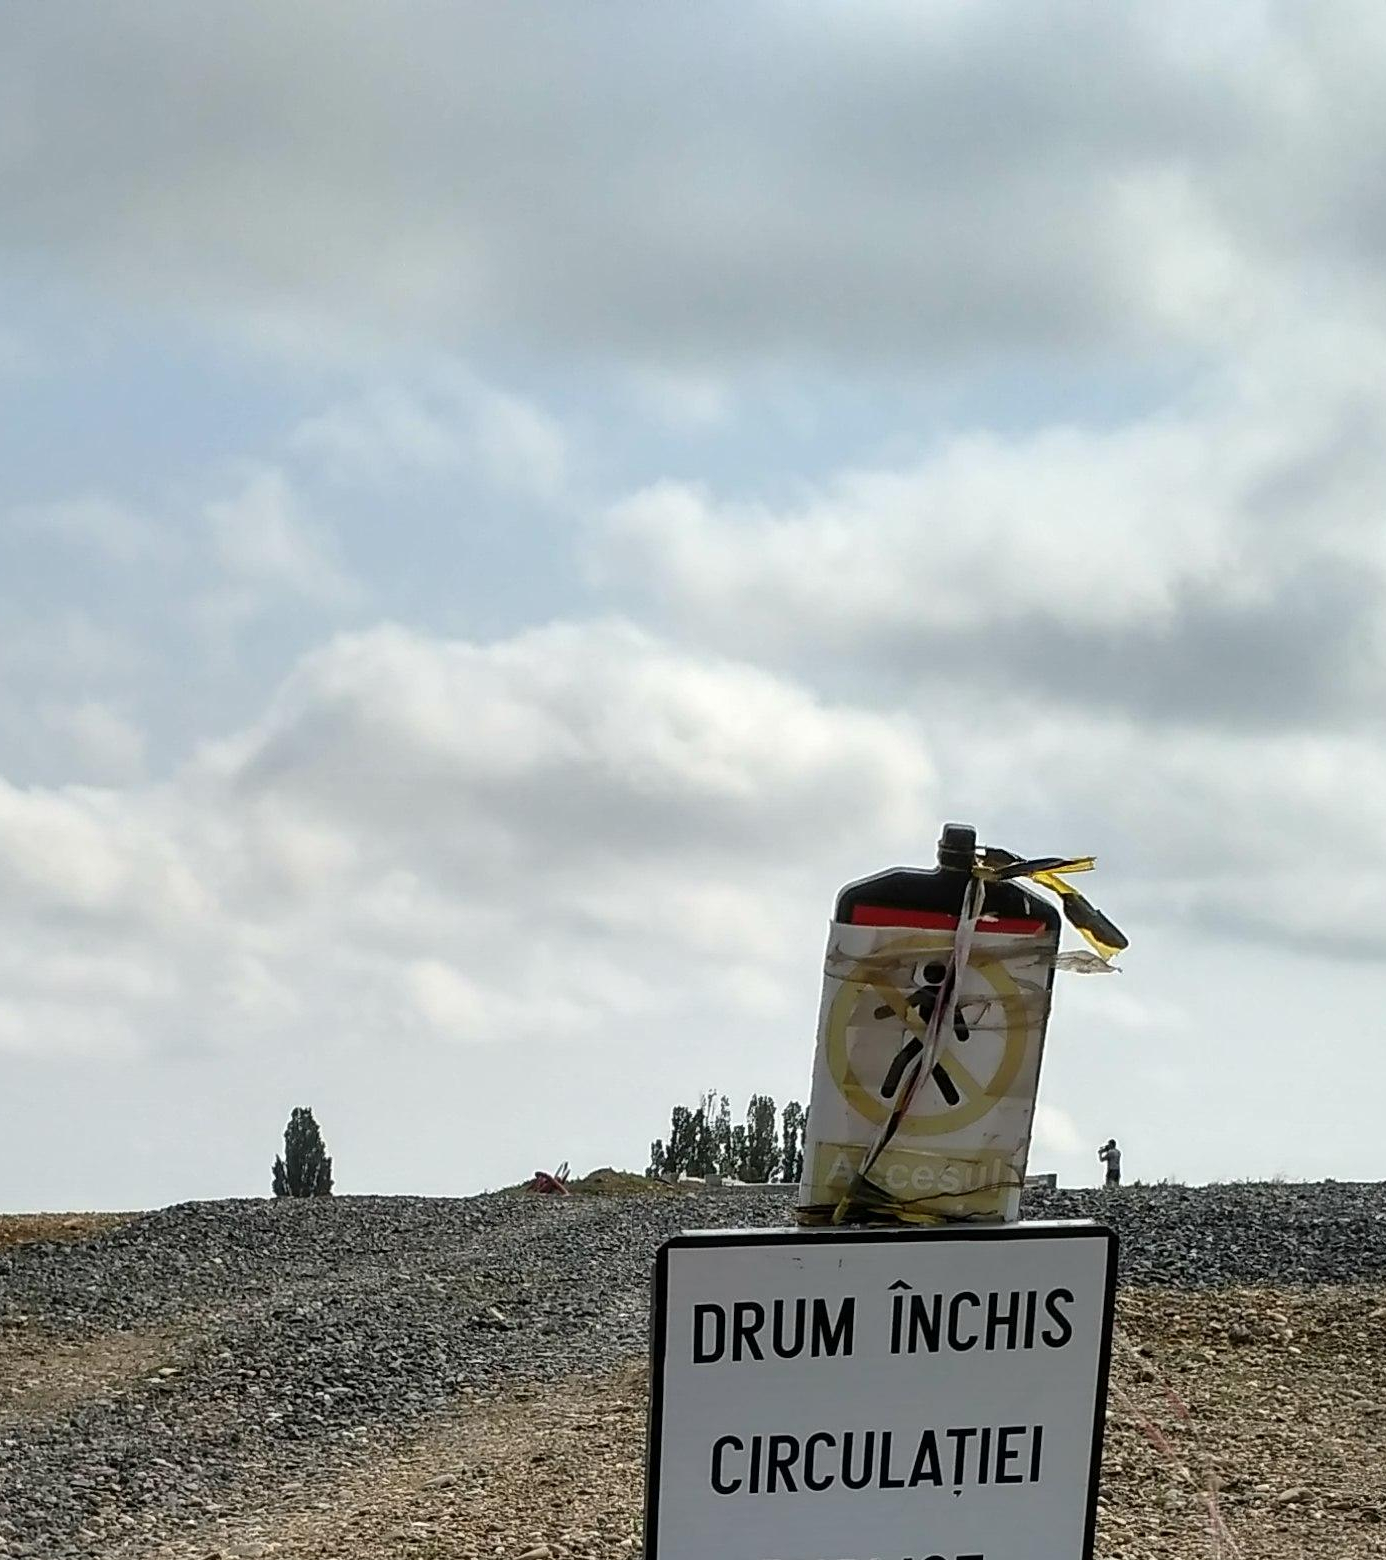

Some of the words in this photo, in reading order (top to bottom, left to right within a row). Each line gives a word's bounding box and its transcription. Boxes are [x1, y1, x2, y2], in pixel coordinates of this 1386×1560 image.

[824, 1152, 1002, 1192] Acesul
[693, 1297, 856, 1364] DRUM
[886, 1279, 1075, 1355] ÎNCHIS
[711, 1425, 1043, 1498] CIRCULAȚIEI
